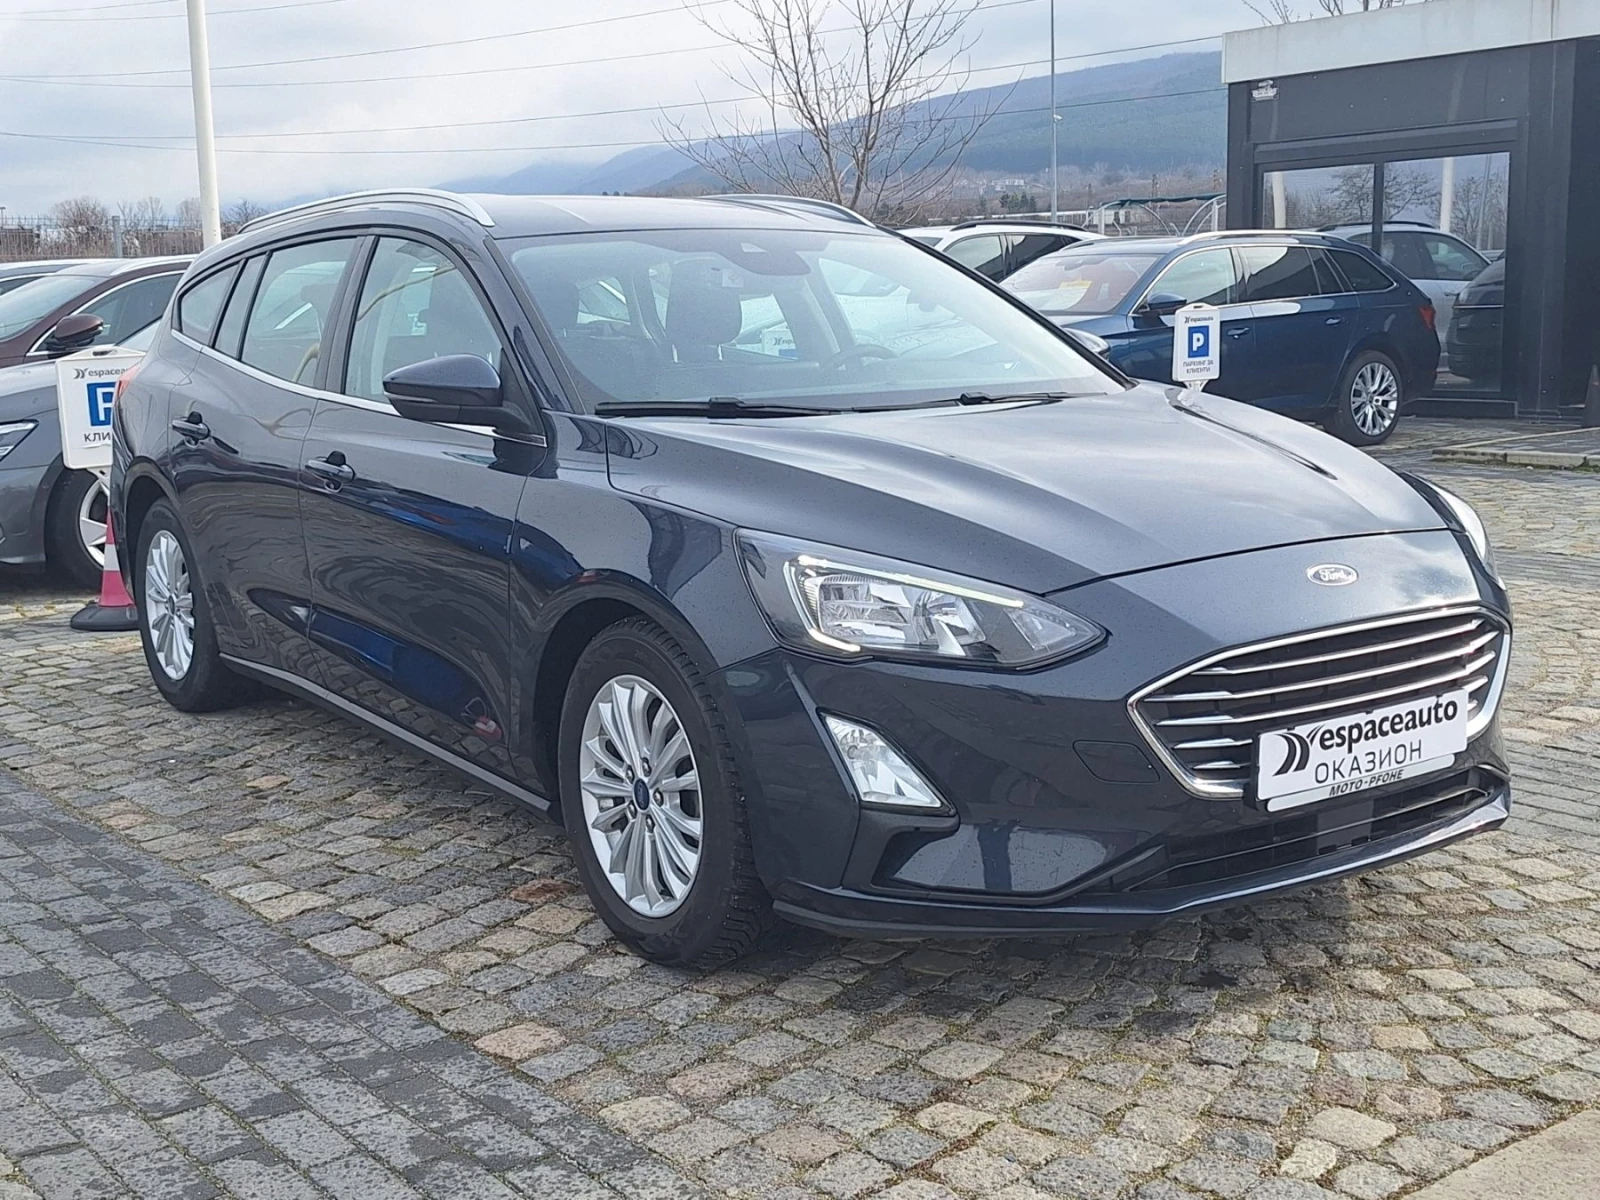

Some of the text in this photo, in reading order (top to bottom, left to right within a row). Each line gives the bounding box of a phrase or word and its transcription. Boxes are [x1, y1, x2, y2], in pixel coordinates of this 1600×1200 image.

[1192, 332, 1205, 352] P
[88, 368, 128, 378] espacea
[1318, 697, 1458, 754] espaceauto
[1315, 739, 1422, 784] ОКАЗИОН
[1329, 769, 1404, 797] MOTO-PFOHE
